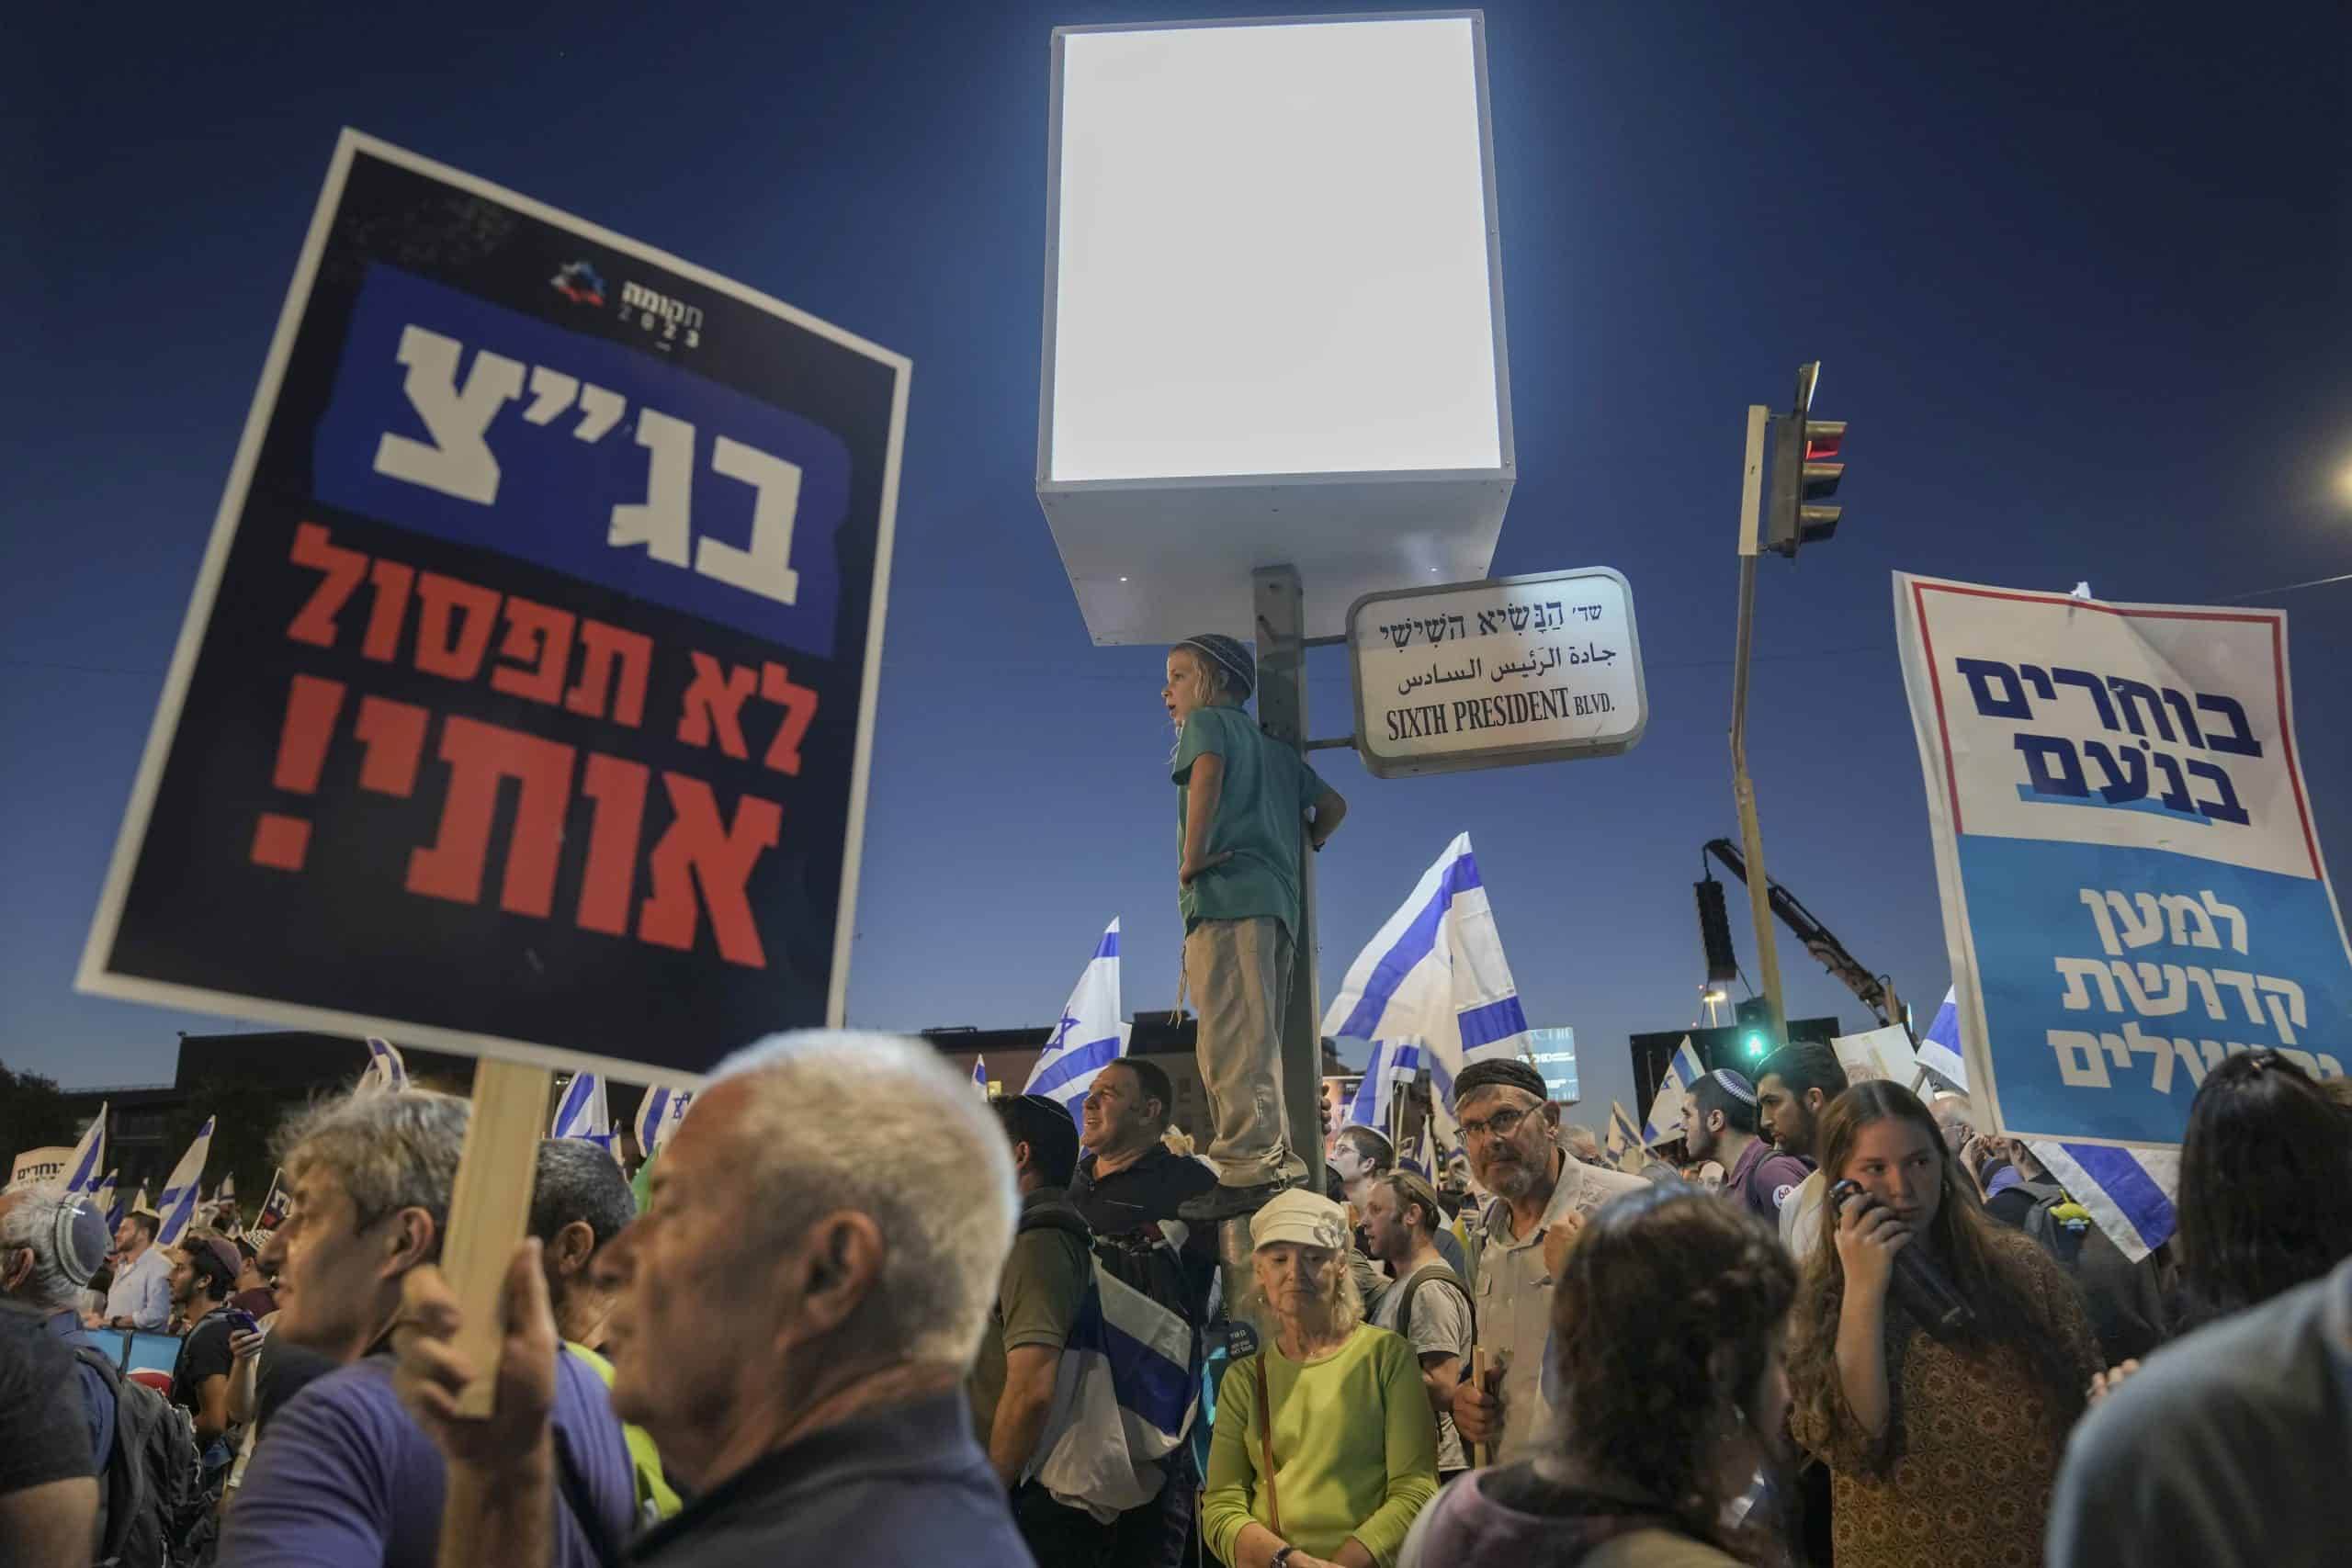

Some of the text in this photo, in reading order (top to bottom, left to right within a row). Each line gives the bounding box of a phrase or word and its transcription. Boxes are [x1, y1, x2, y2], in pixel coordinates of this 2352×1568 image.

[287, 522, 819, 777] לא תפסול
[1398, 656, 1482, 695] السادس
[1569, 642, 1617, 666] جادة
[1385, 687, 1615, 741] SIXTH PRESIDENT BLVD.
[1955, 657, 2264, 759] בוחרים
[251, 672, 783, 969] אותי!
[2079, 887, 2249, 956] למען
[2054, 956, 2308, 1045] קדושת
